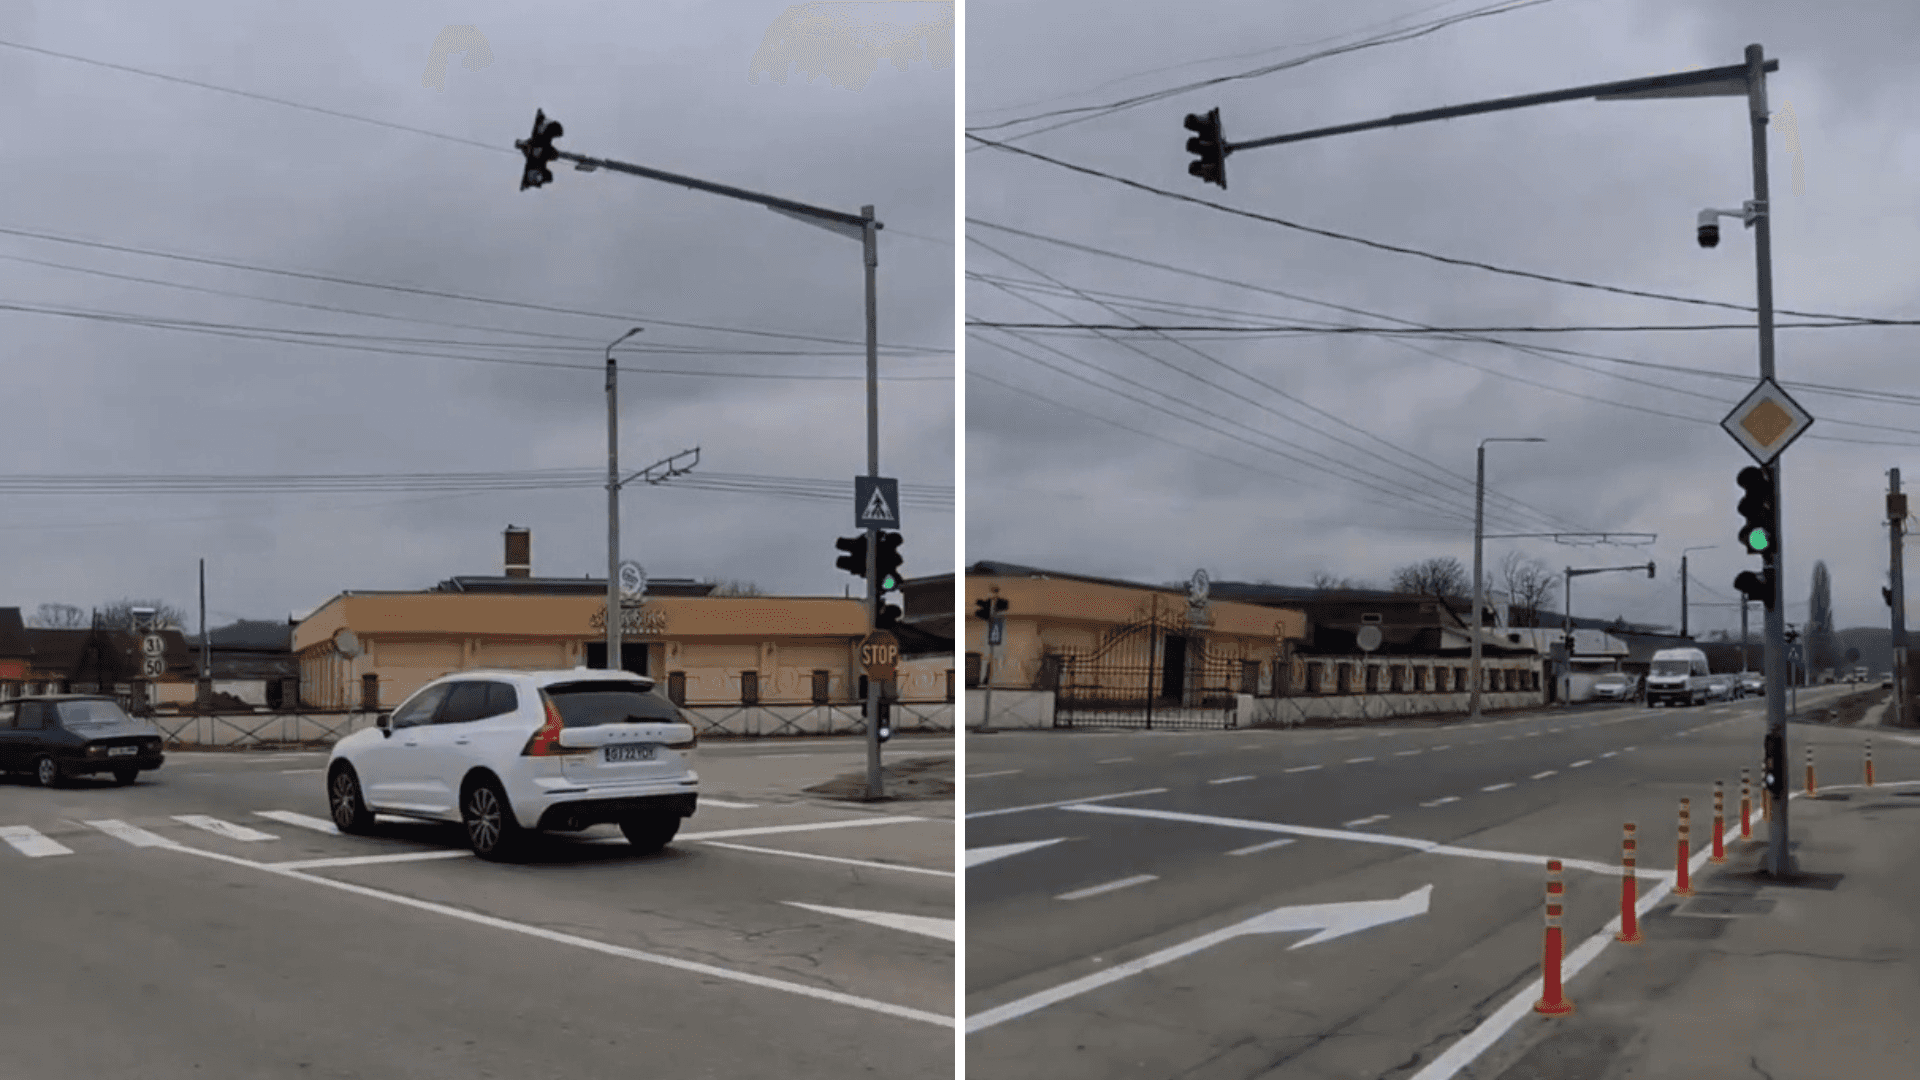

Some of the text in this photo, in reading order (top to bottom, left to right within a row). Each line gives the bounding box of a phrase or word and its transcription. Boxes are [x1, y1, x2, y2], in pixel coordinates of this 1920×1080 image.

[147, 639, 161, 652] 31
[862, 645, 898, 665] STOP
[147, 660, 162, 674] 50
